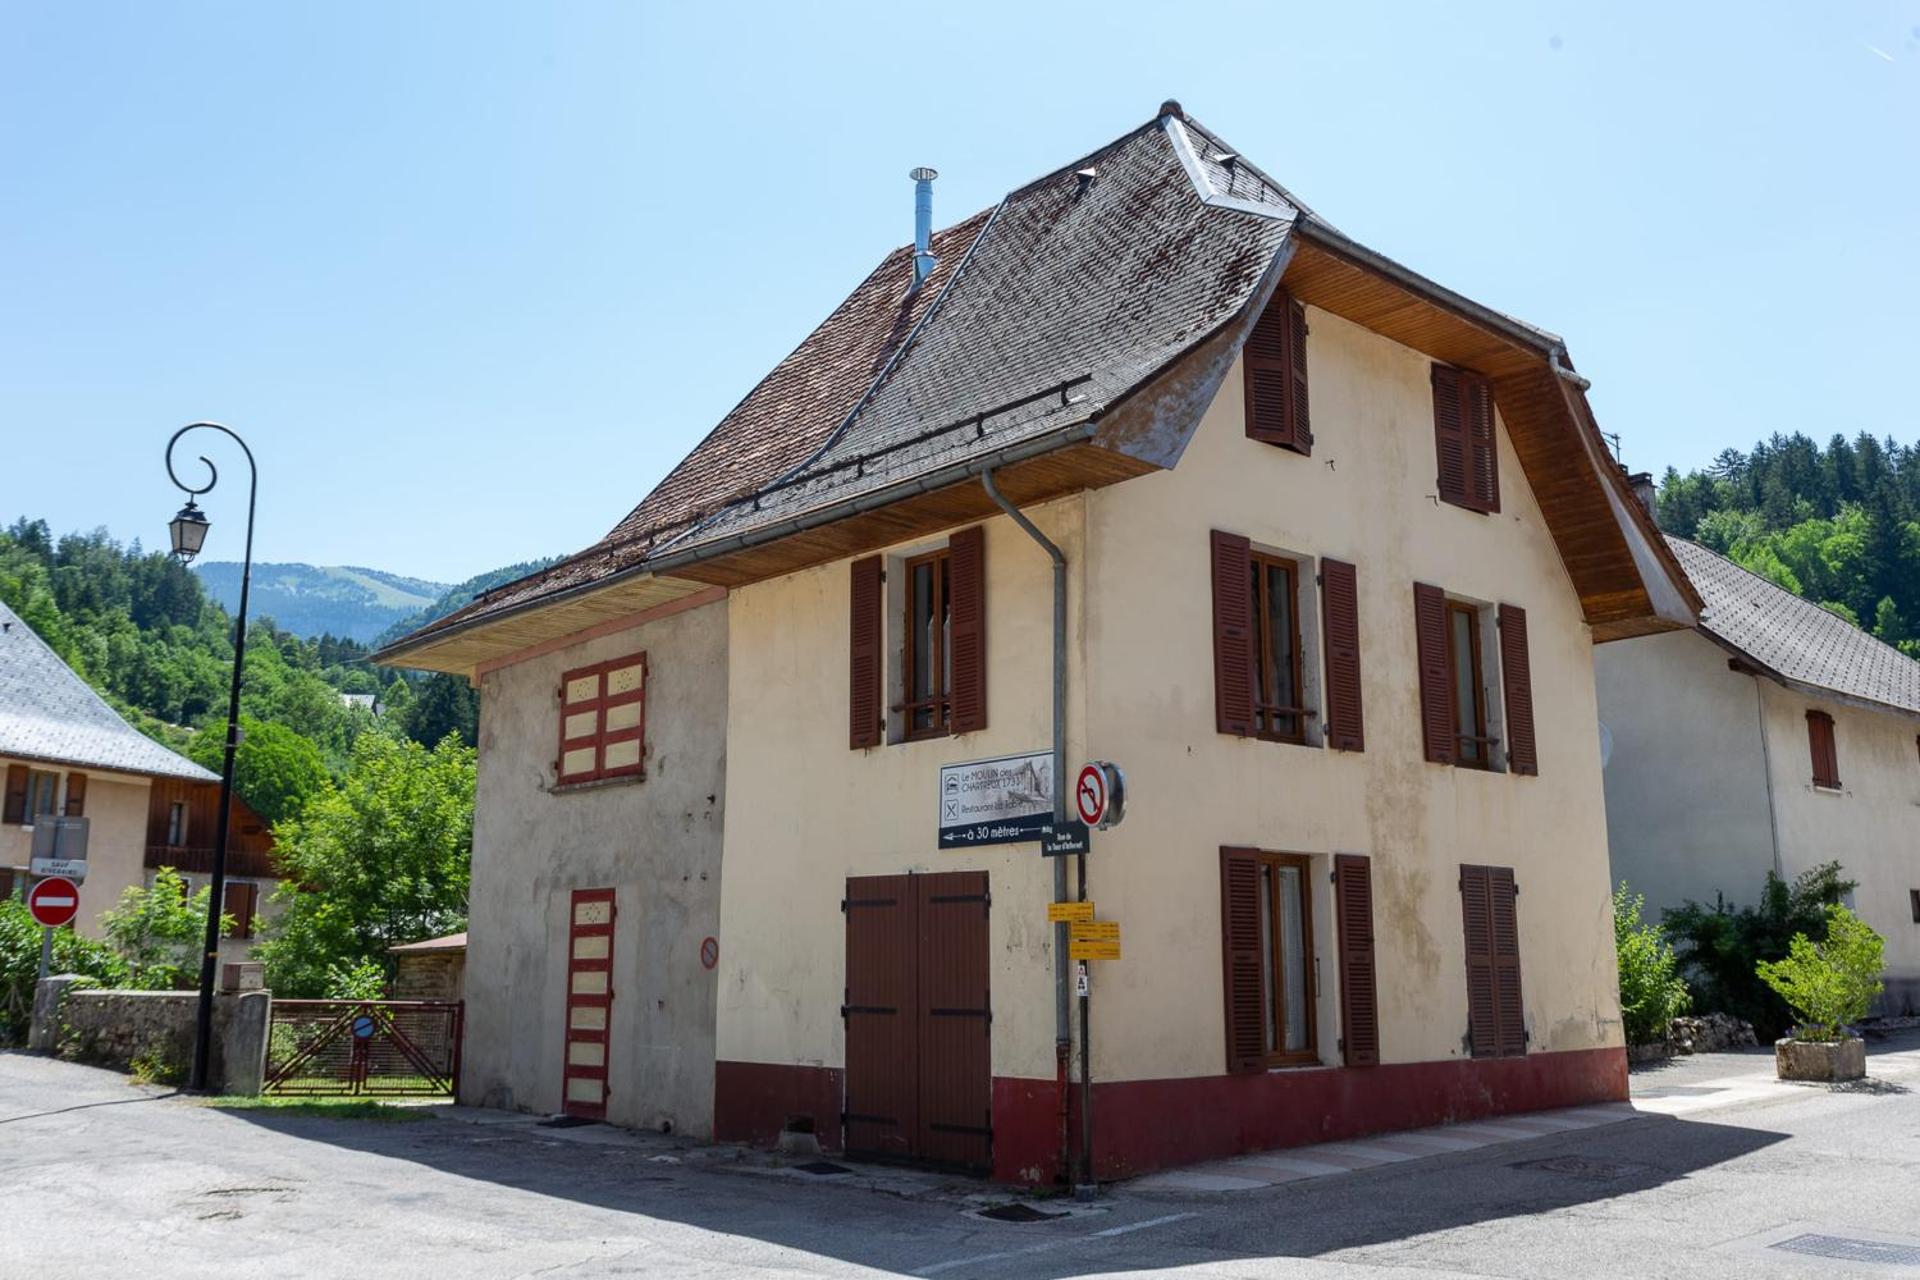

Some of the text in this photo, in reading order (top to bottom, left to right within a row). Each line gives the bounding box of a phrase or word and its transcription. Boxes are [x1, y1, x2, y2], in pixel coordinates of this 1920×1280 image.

[961, 774, 969, 782] Le
[971, 768, 999, 781] MOULIN
[967, 826, 1020, 841] à 30 mètres
